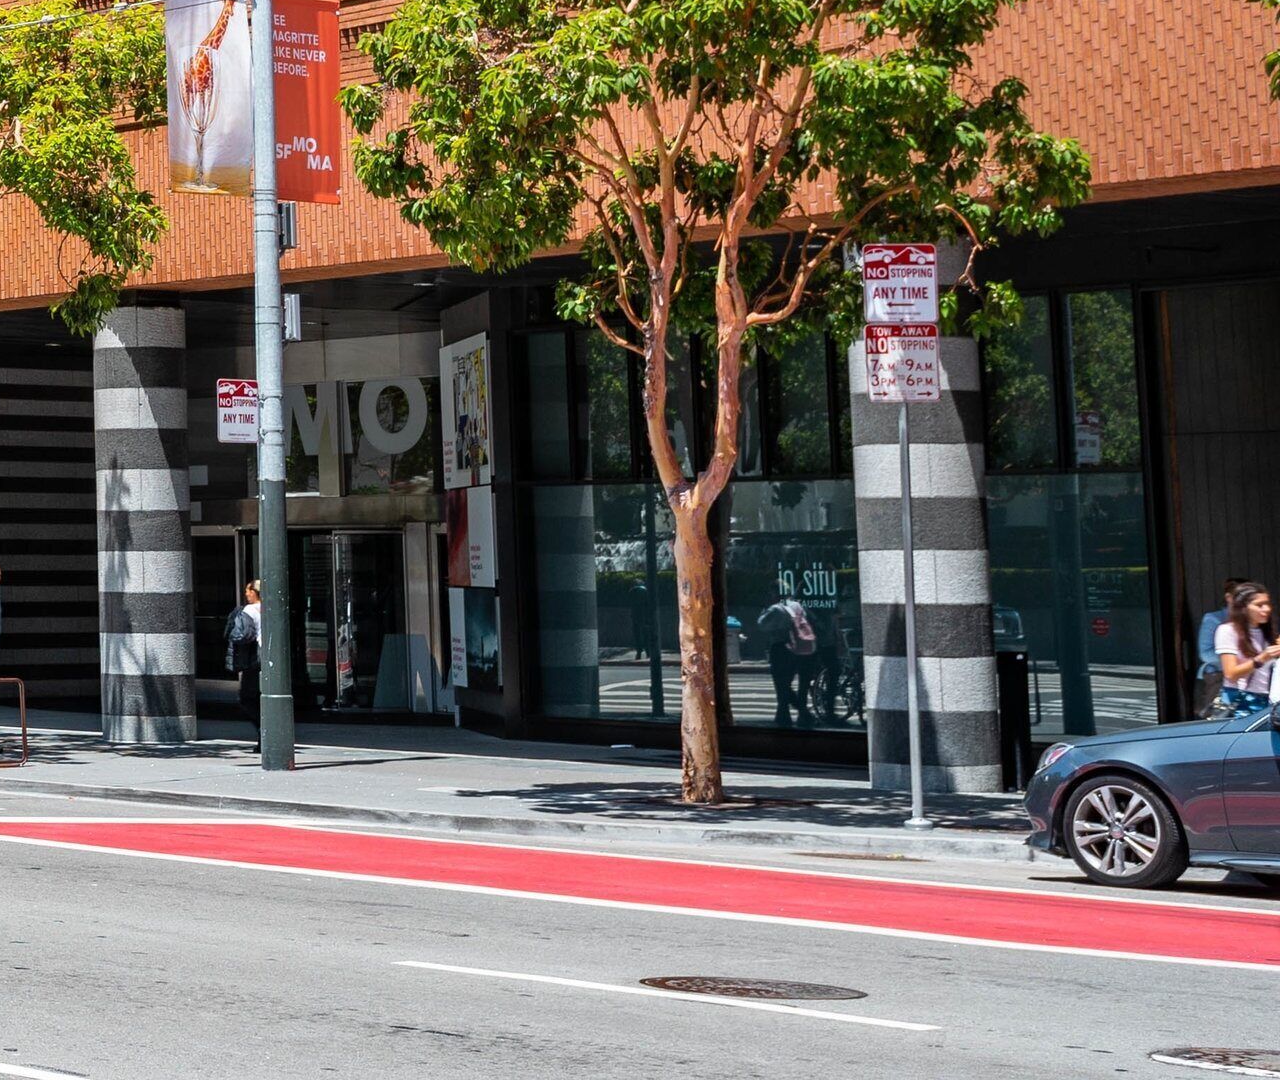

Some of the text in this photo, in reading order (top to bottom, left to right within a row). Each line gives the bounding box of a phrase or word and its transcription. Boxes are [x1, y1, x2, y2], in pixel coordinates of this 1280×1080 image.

[273, 14, 286, 26] EE
[274, 46, 326, 62] IKE NEVER
[275, 143, 292, 159] SF
[292, 136, 317, 153] MO
[307, 154, 333, 171] MA
[866, 267, 933, 279] NO STOPPING
[873, 287, 929, 300] ANY TIME
[866, 337, 936, 353] NO STOPPING
[220, 397, 257, 408] NO STOPPING
[222, 413, 255, 425] ANY TIME
